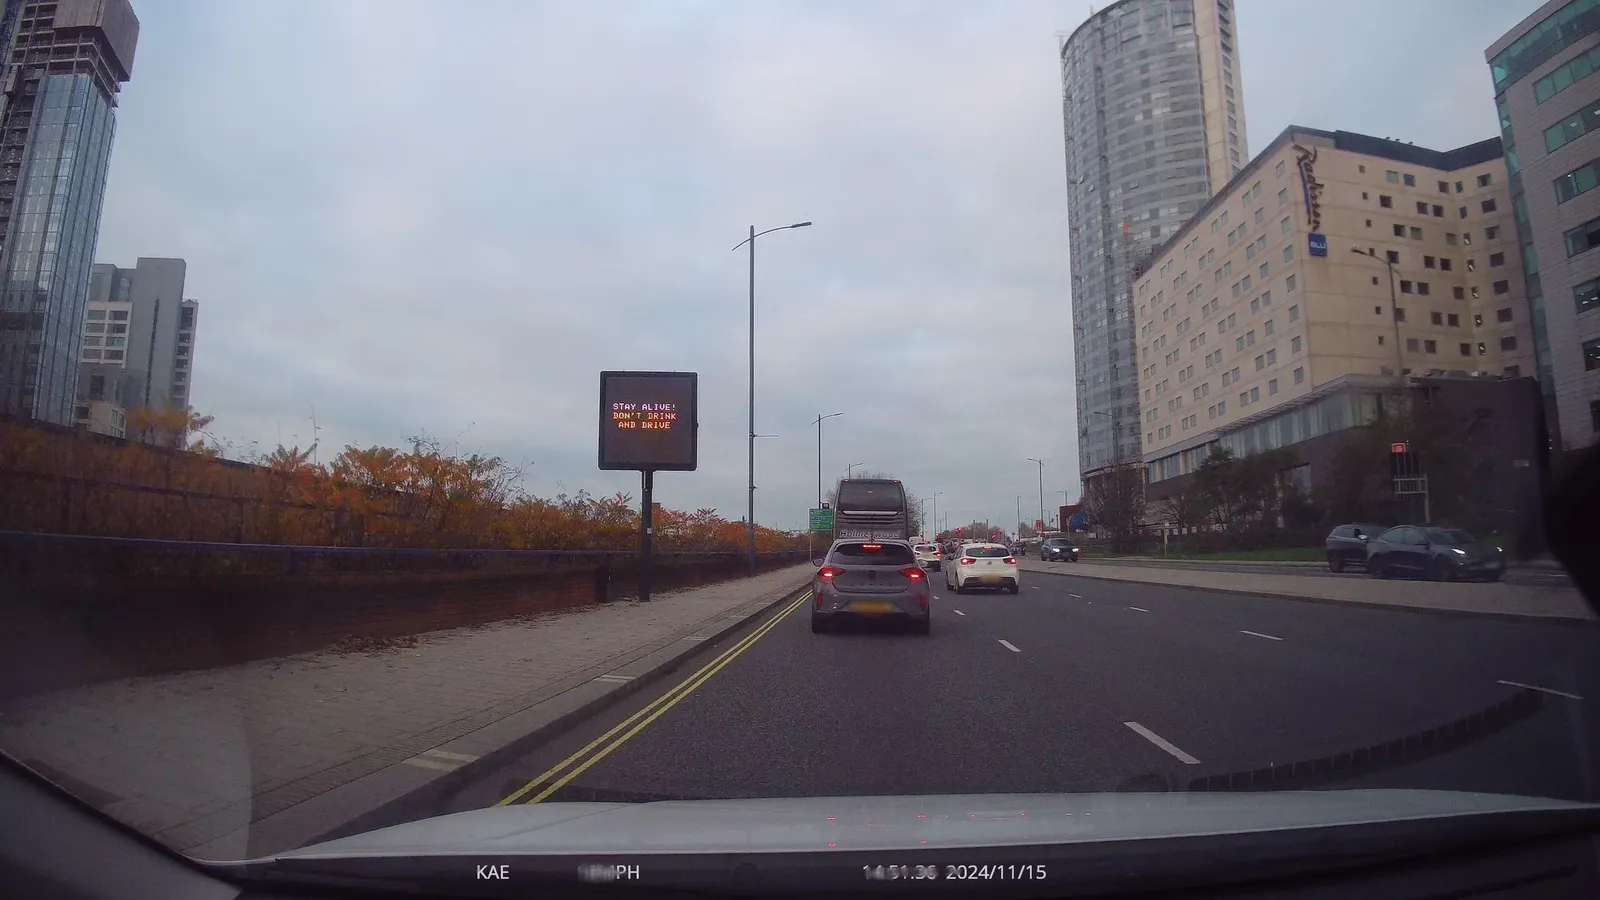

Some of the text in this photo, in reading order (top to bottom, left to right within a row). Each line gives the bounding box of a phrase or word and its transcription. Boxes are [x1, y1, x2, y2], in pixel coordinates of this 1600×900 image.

[1292, 144, 1325, 232] Radisson
[1310, 241, 1326, 249] BLU
[613, 402, 676, 411] STAY ALIVE!
[612, 412, 676, 420] DON'T DRINK
[618, 421, 671, 429] AND DRIVE
